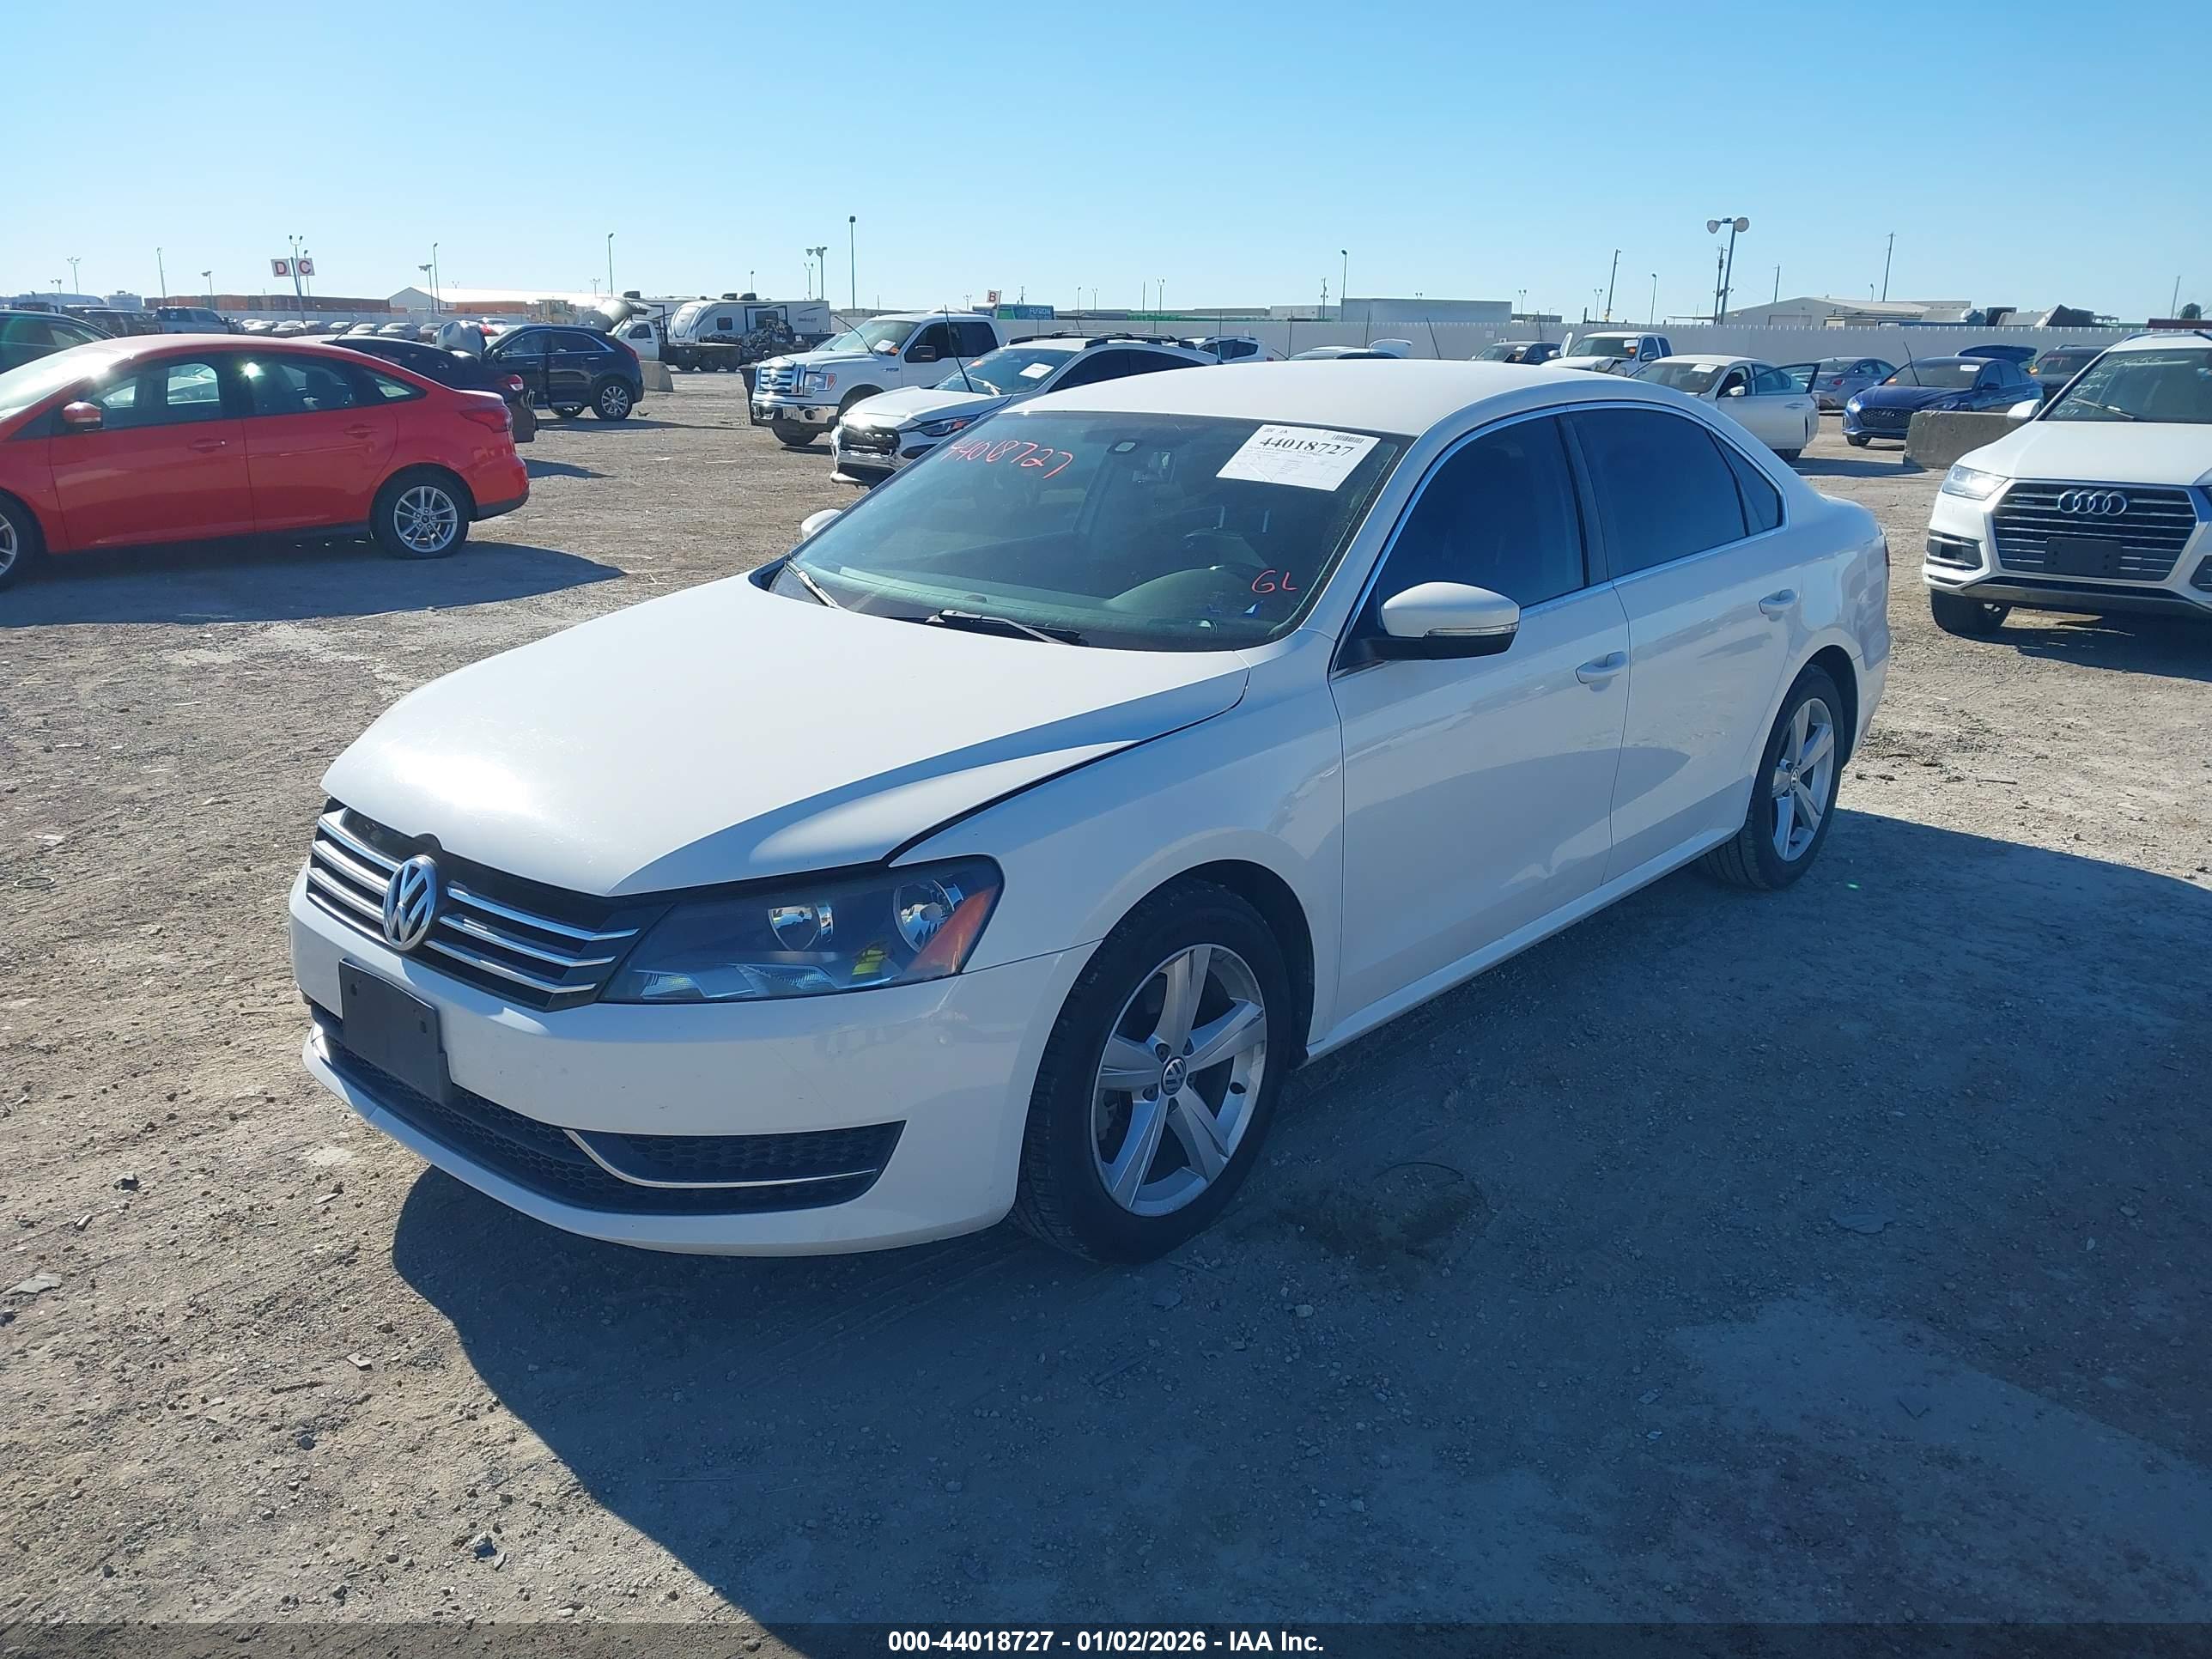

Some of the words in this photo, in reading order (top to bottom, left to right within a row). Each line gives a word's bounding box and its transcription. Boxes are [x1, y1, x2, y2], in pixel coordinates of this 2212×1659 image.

[274, 261, 288, 275] D
[298, 259, 311, 274] C
[988, 291, 997, 302] B
[1260, 436, 1355, 458] 44018727
